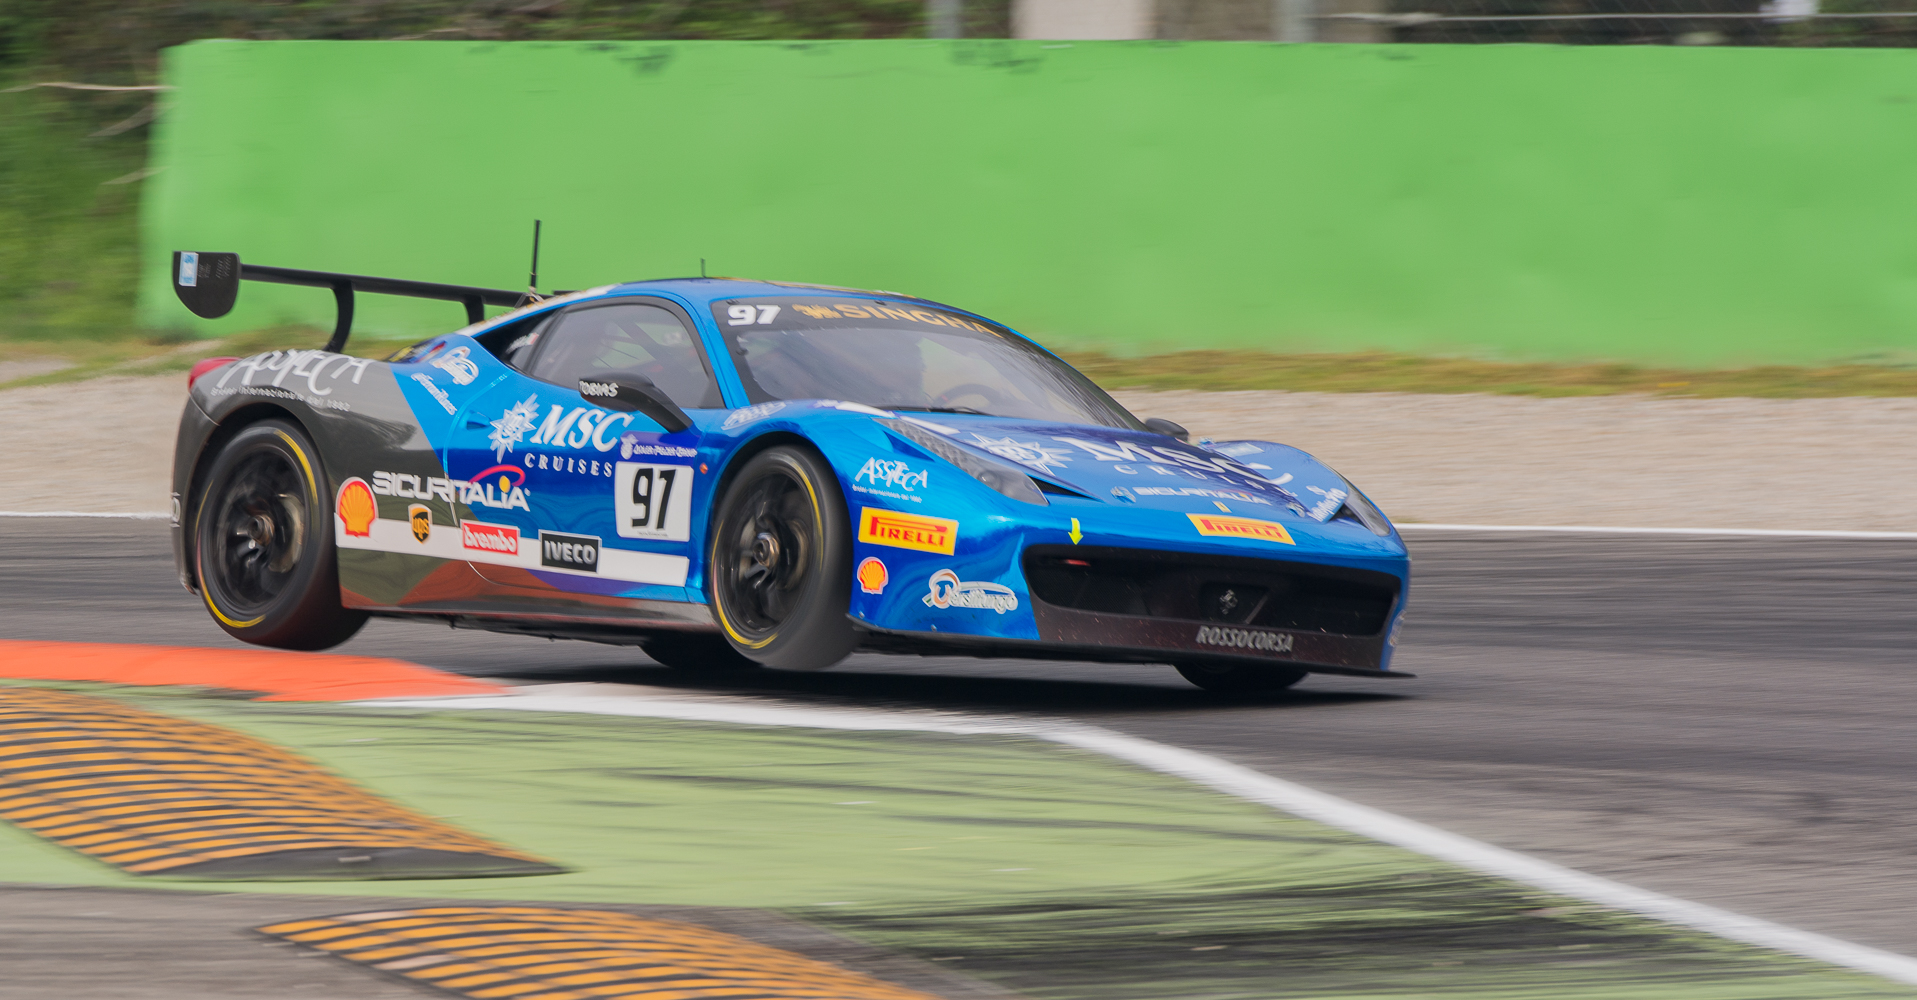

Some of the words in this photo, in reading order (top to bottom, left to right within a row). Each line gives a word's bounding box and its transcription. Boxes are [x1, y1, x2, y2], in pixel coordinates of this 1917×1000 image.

[727, 304, 782, 326] 97
[833, 304, 1005, 339] SINGHA
[529, 404, 636, 452] MSC
[524, 453, 613, 478] CRUISES
[1050, 436, 1294, 486] MSC
[631, 467, 677, 530] 97
[412, 517, 430, 540] ups
[464, 525, 517, 553] brembo
[869, 515, 949, 548] PIRELLI
[1199, 518, 1285, 540] PIRELLI
[544, 540, 597, 566] IVECO
[1195, 625, 1294, 653] ROSSOCORSA
